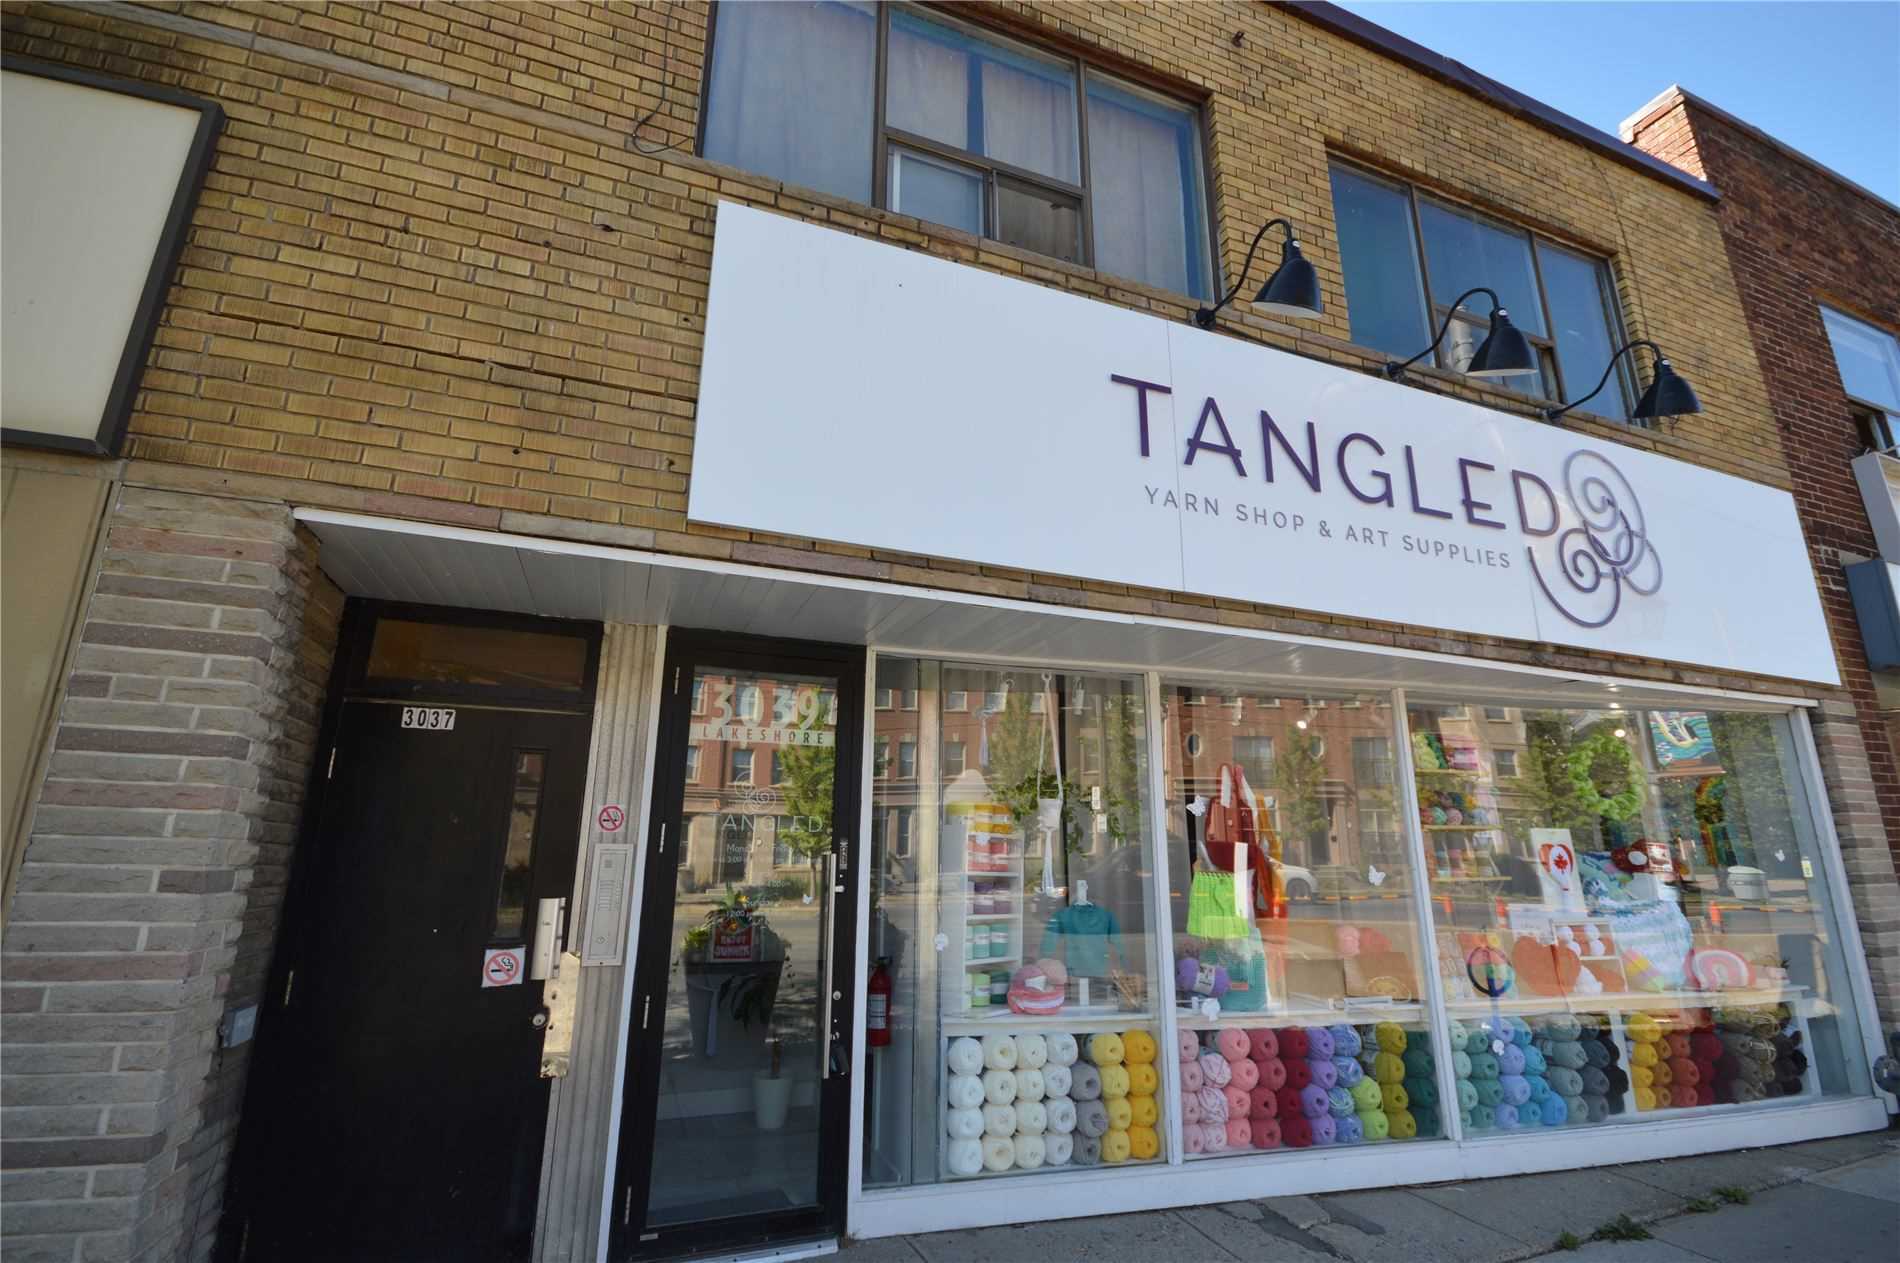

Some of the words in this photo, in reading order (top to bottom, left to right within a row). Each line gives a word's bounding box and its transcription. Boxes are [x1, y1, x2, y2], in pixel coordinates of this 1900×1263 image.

[1111, 373, 1560, 537] TANGLED
[1145, 485, 1219, 516] YARN
[1236, 504, 1304, 531] SHOP
[1319, 520, 1332, 538] &
[1345, 525, 1389, 547] ART
[1402, 535, 1511, 569] SUPPLIES
[404, 709, 454, 728] 3037
[712, 684, 820, 730] 3039
[703, 726, 824, 744] LAKESHORE
